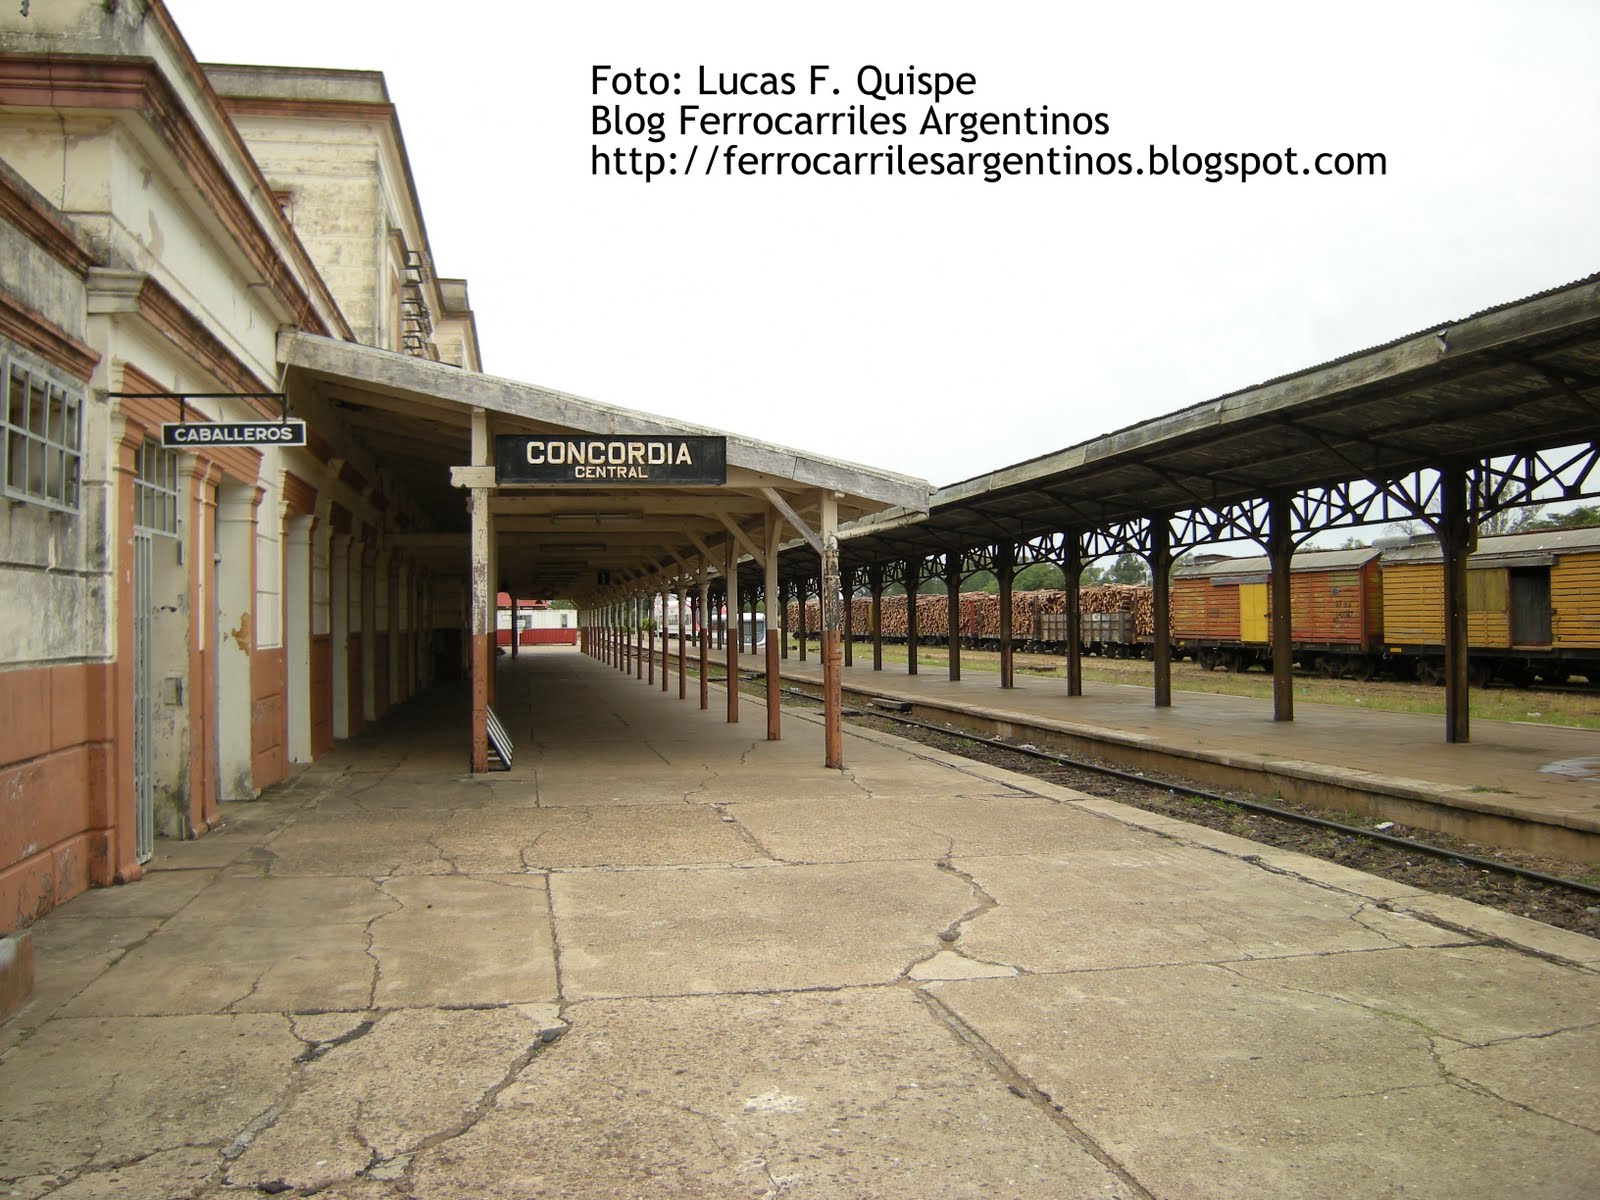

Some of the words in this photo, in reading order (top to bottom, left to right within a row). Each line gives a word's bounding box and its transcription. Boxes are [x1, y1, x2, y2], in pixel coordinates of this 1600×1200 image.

[174, 427, 293, 442] CABALLEROS
[526, 441, 693, 465] CONCORDIA
[574, 466, 649, 479] CENTRAL
